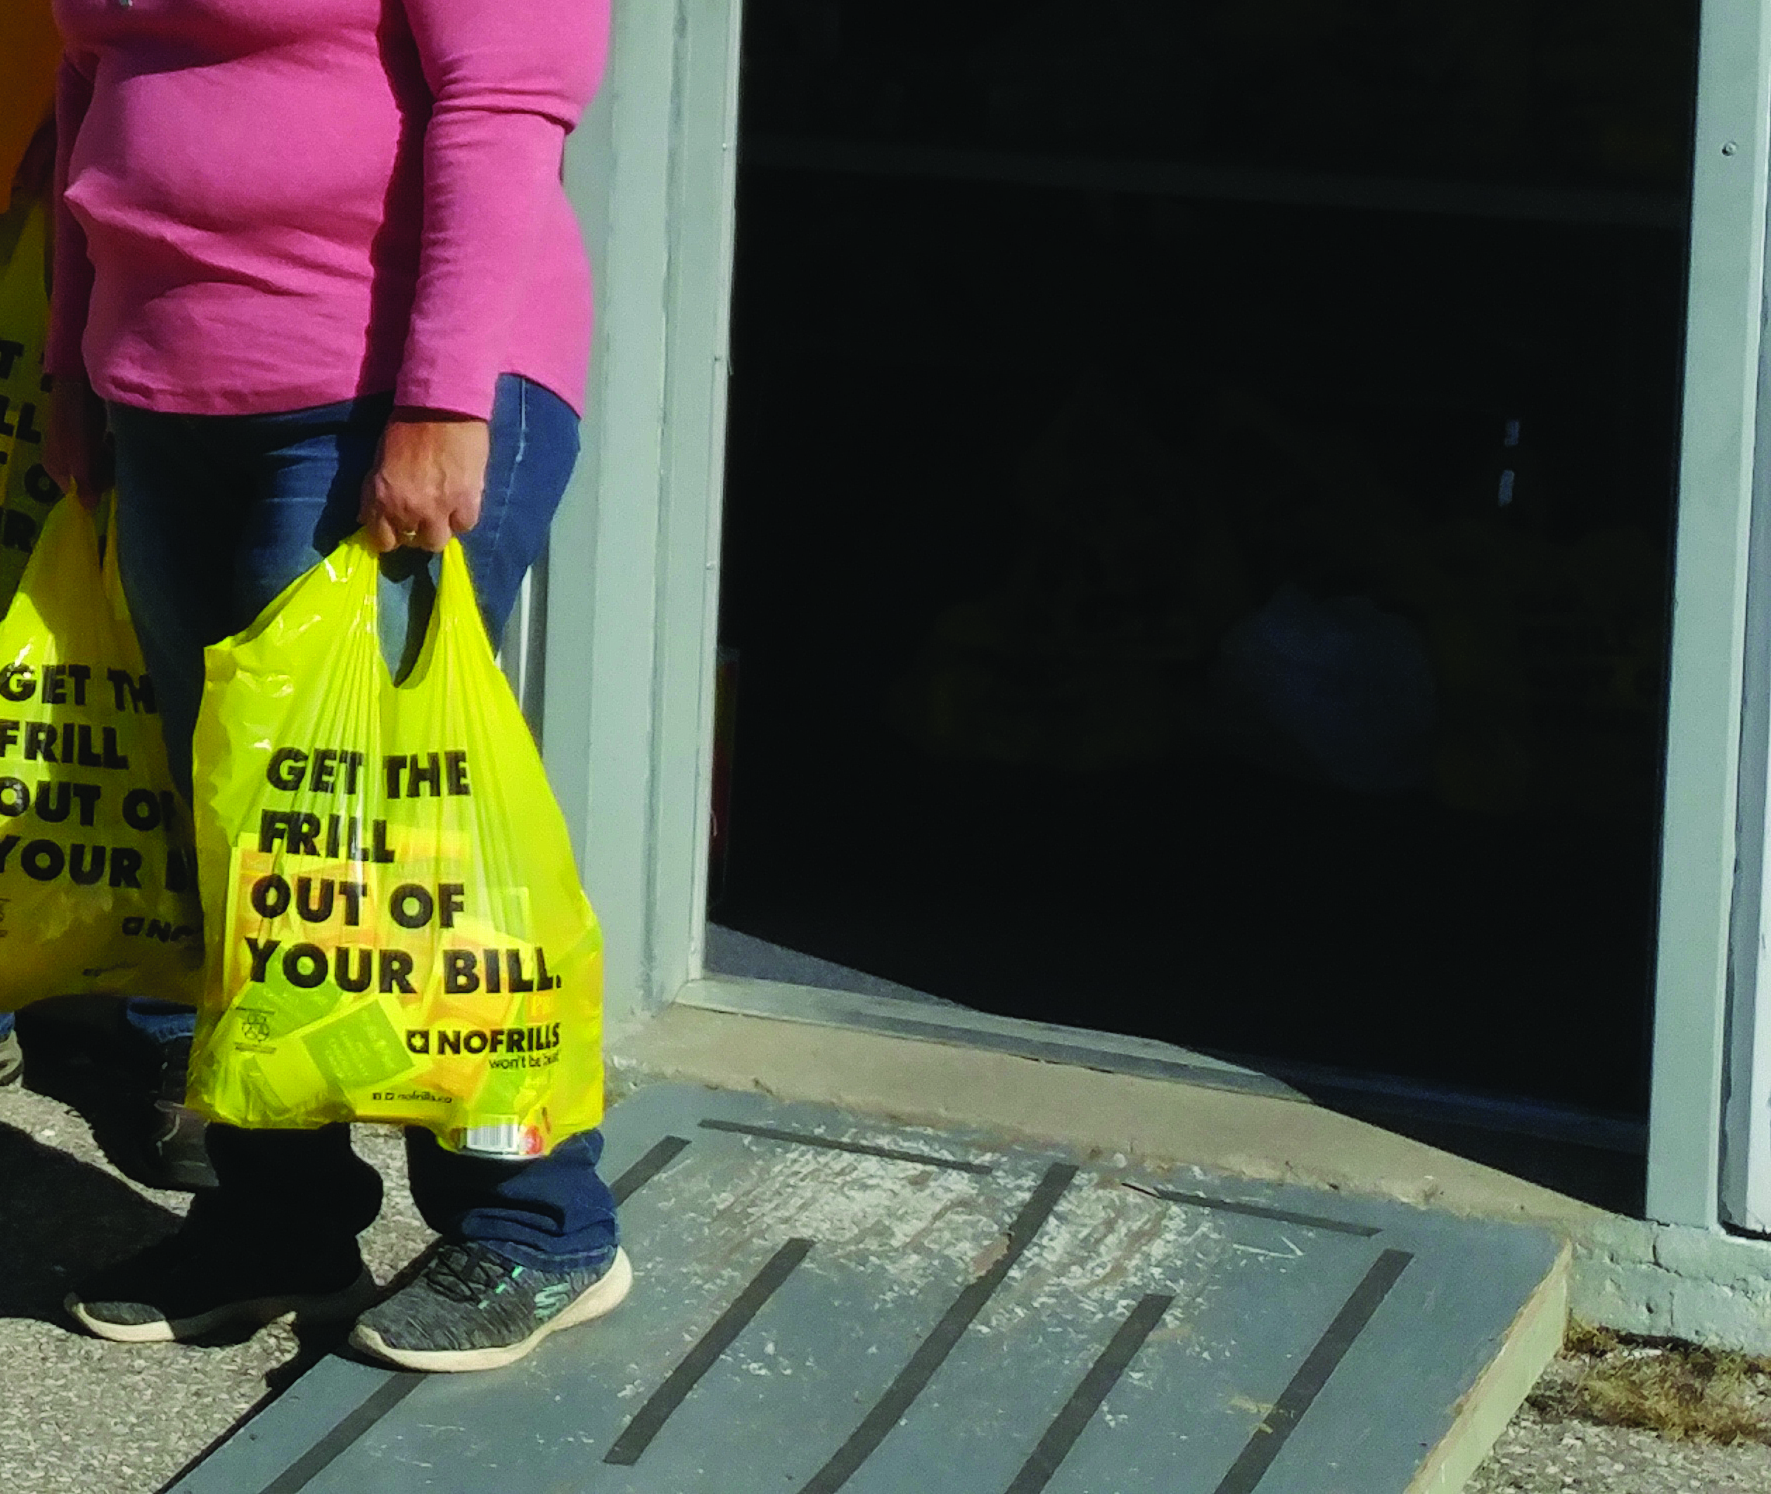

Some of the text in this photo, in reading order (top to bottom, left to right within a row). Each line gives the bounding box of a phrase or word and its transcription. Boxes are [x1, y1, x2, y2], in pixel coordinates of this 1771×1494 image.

[266, 747, 471, 799] GET THE
[259, 810, 396, 863] FRILL
[251, 873, 464, 928] OUT OF
[245, 937, 561, 994] YOUR BILL.
[437, 1022, 560, 1055] NOFRILLS
[488, 1055, 526, 1069] won't
